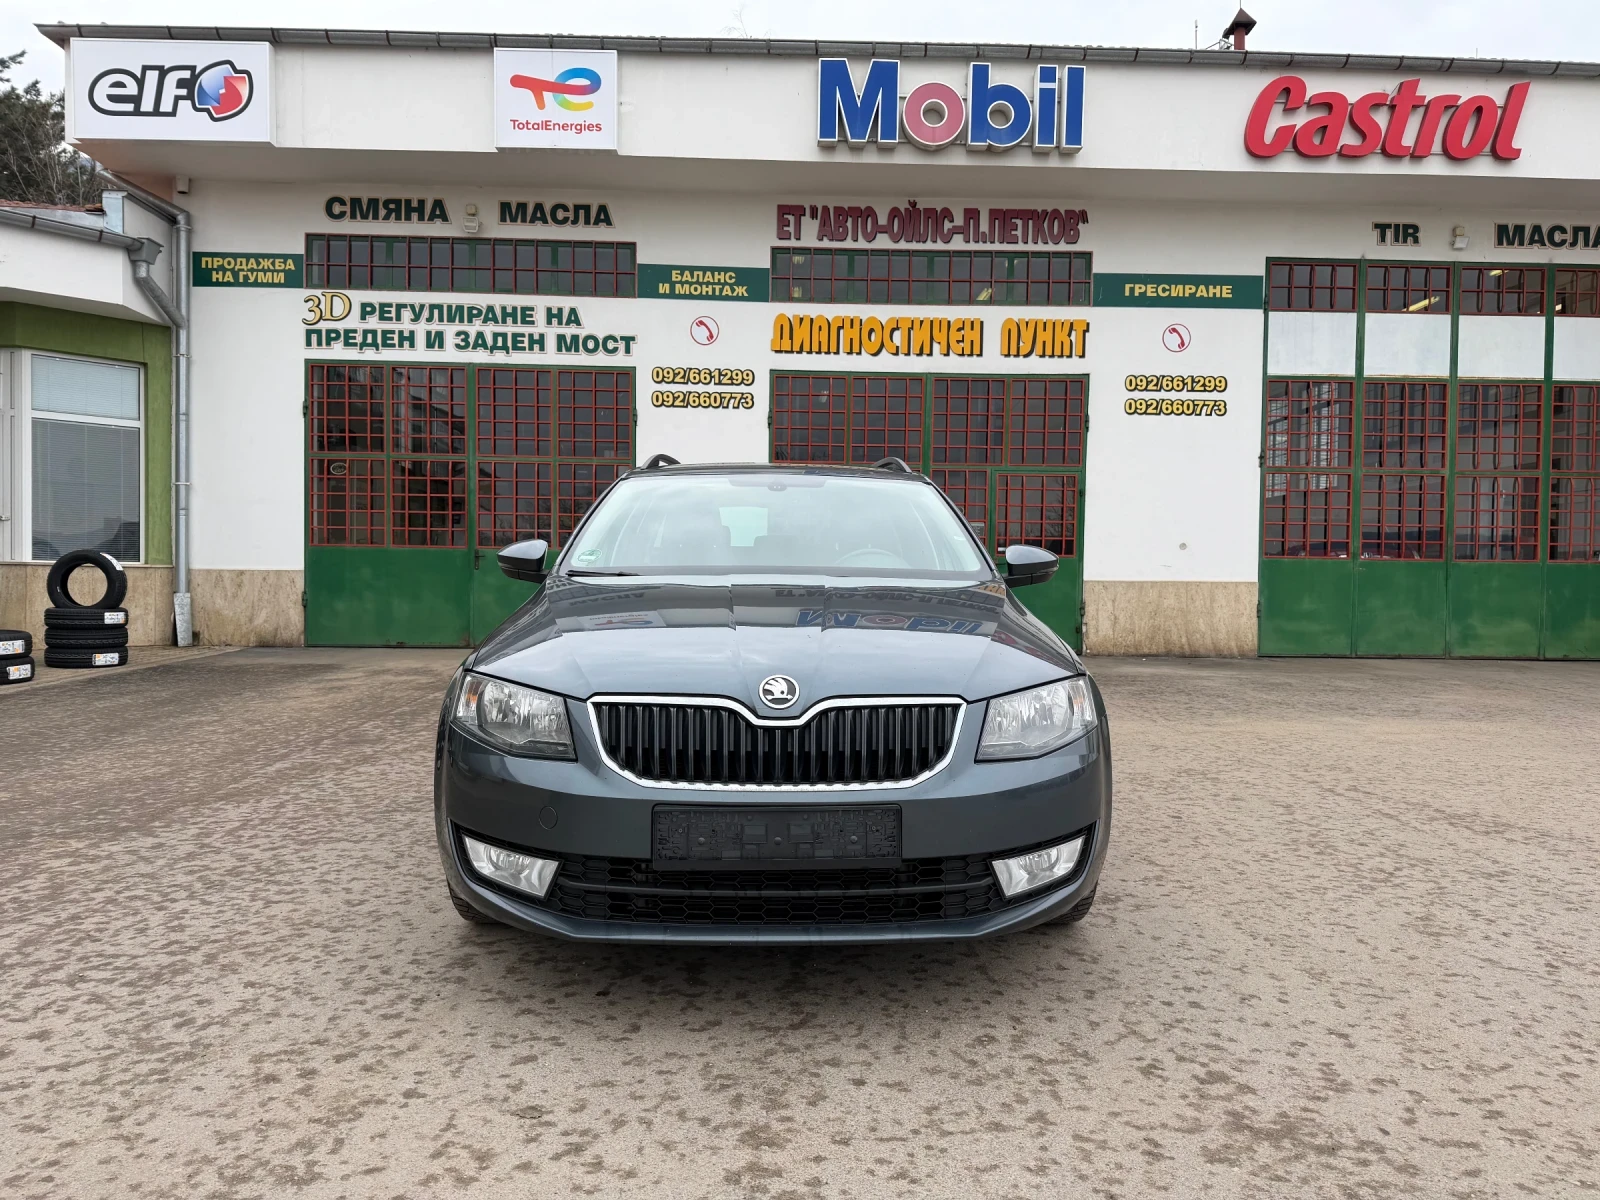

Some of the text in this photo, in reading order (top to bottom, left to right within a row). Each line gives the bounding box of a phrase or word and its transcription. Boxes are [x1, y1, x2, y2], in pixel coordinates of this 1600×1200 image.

[88, 64, 197, 118] elf
[817, 57, 1087, 155] Mobil
[509, 118, 603, 135] TotalEnergies
[1244, 74, 1532, 161] Castrol
[325, 196, 615, 228] СМЯНА МАСЛА
[776, 204, 806, 241] ЕТ
[1373, 222, 1420, 246] TIR
[201, 257, 296, 272] ПРОДАЖБА
[212, 270, 286, 285] НА ГУМИ
[671, 270, 736, 284] БАЛАНС
[658, 283, 749, 297] И МОНТАЖ
[1124, 283, 1233, 299] ГРЕСИРАНЕ
[302, 291, 583, 328] 3D РЕГУЛИРАНЕ НА
[304, 328, 638, 356] ПРЕДЕН И ЗАДЕН МОСТ
[771, 313, 1090, 358] ДИАГНОСТИЧЕН ПУНКТ
[652, 366, 755, 386] 092/661299
[1124, 374, 1228, 394] 092/661299
[651, 390, 755, 409] 092/660773
[1124, 398, 1227, 417] 092/660773
